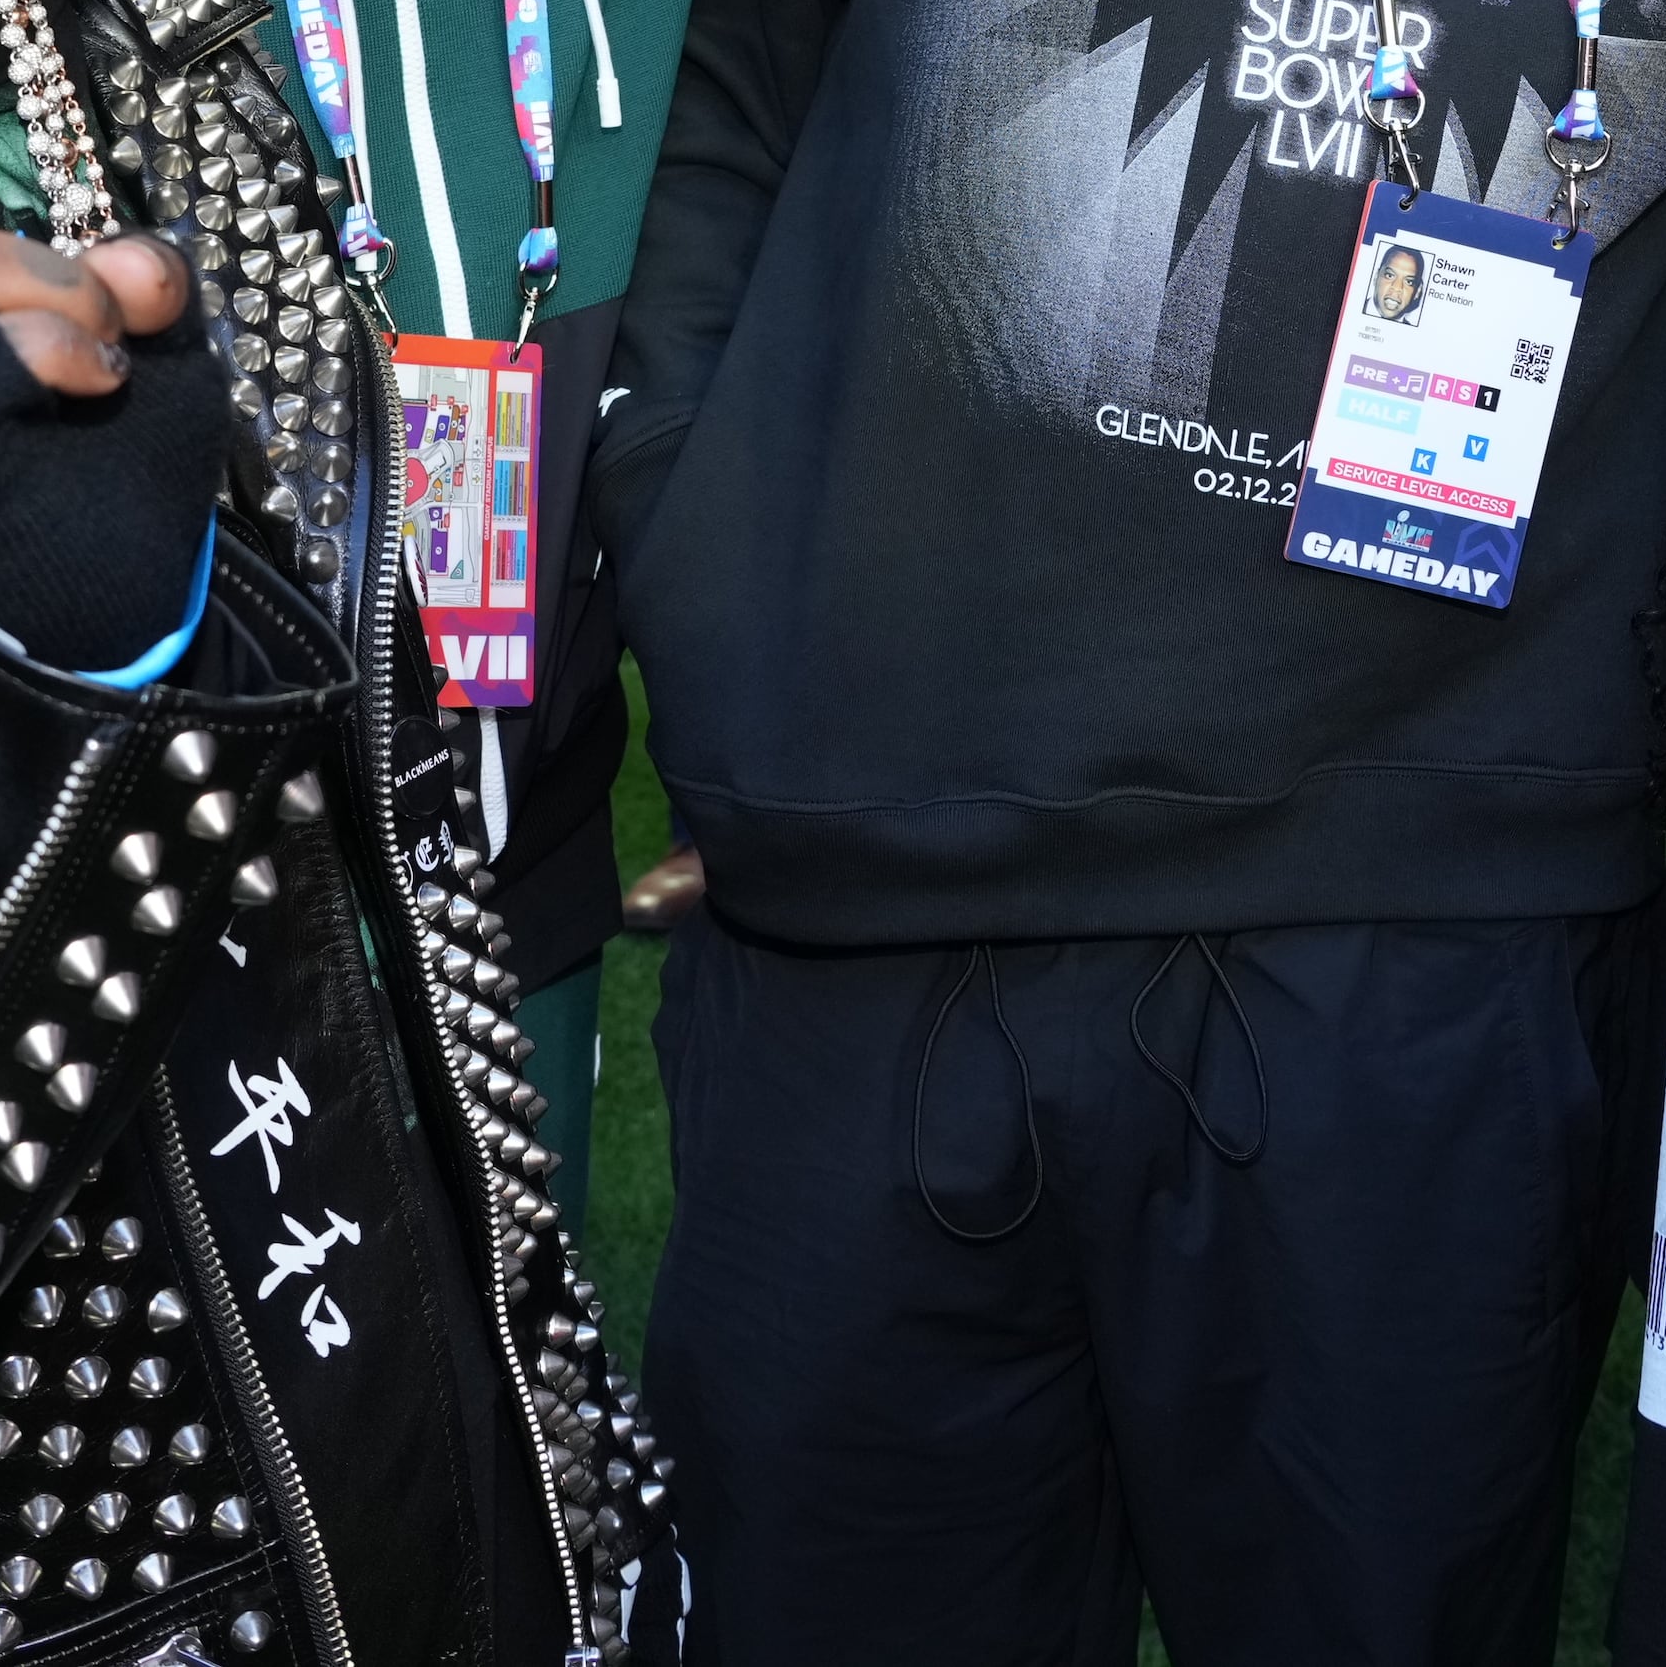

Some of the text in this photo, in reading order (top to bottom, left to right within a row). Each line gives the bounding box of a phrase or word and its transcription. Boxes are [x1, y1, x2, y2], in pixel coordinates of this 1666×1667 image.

[532, 101, 555, 167] LVII
[1267, 110, 1364, 179] LVII
[1432, 273, 1470, 291] Carter
[1435, 258, 1476, 277] Shawn
[1428, 288, 1474, 308] Roc Nation
[1351, 364, 1493, 407] PRE R S 1
[1348, 397, 1412, 424] HALF
[1096, 404, 1272, 470] GLENDALE,
[1469, 439, 1485, 456] V
[1415, 453, 1432, 471] K
[484, 436, 494, 541] GAMEDAY STADIUM CAMPUS
[1333, 461, 1509, 514] SERVICE LEVEL ACCESS
[1302, 531, 1500, 598] GAMEDAY
[425, 635, 527, 680] VII
[394, 748, 450, 788] BLACKMEANS
